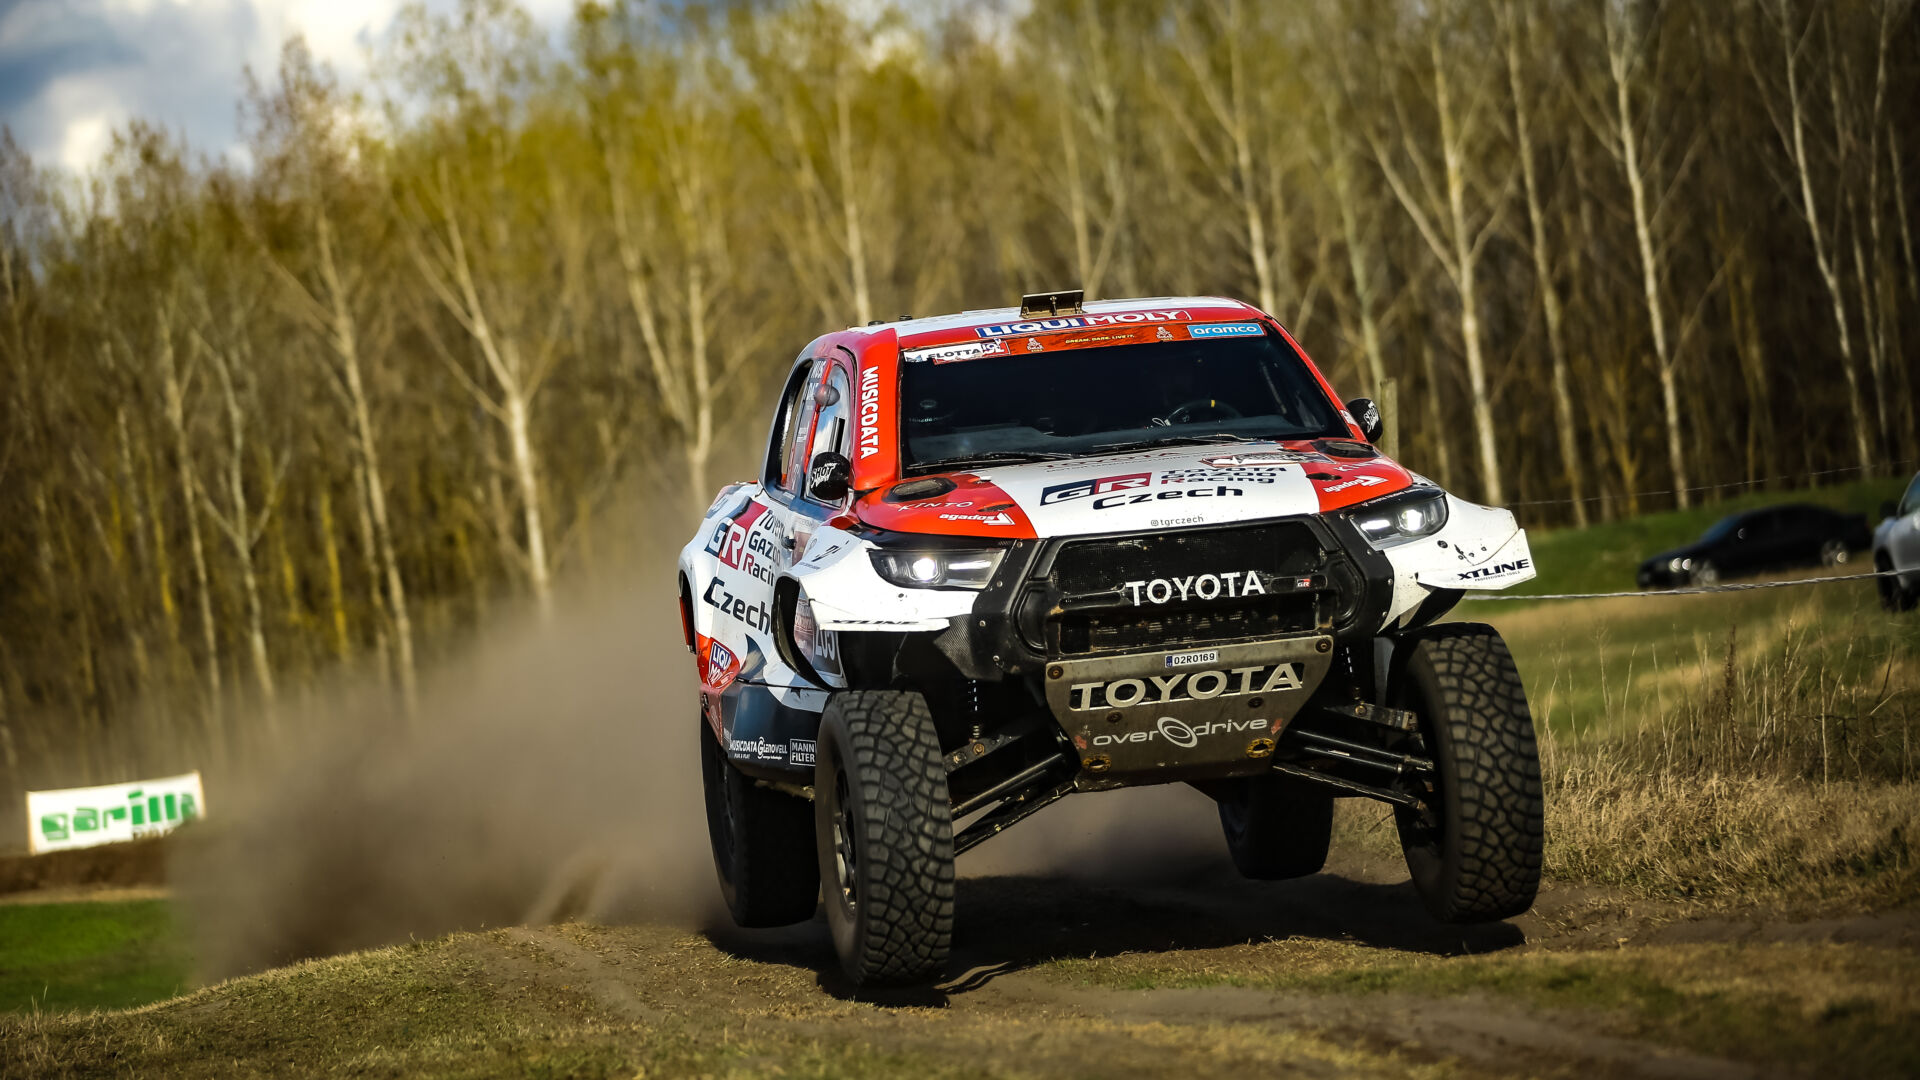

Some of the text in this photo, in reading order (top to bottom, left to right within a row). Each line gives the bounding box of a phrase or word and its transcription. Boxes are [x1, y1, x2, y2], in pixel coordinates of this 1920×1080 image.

[982, 311, 1182, 336] LIQUI MOLY
[1193, 325, 1259, 335] aramco
[860, 366, 879, 459] MUSICDATA
[1043, 475, 1149, 505] GR
[1161, 477, 1275, 485] Racing
[897, 501, 974, 512] KINTO
[1092, 486, 1243, 510] Czech
[938, 513, 996, 521] agados
[708, 517, 747, 567] GR
[1457, 558, 1530, 580] XTLINE
[1125, 570, 1266, 606] TOYOTA
[703, 577, 772, 636] Czech
[1174, 653, 1215, 664] 02R0169
[1070, 663, 1303, 711] TOYOTA
[729, 740, 757, 753] MUSICDATA
[791, 742, 815, 753] MANN
[791, 752, 816, 763] FILTER
